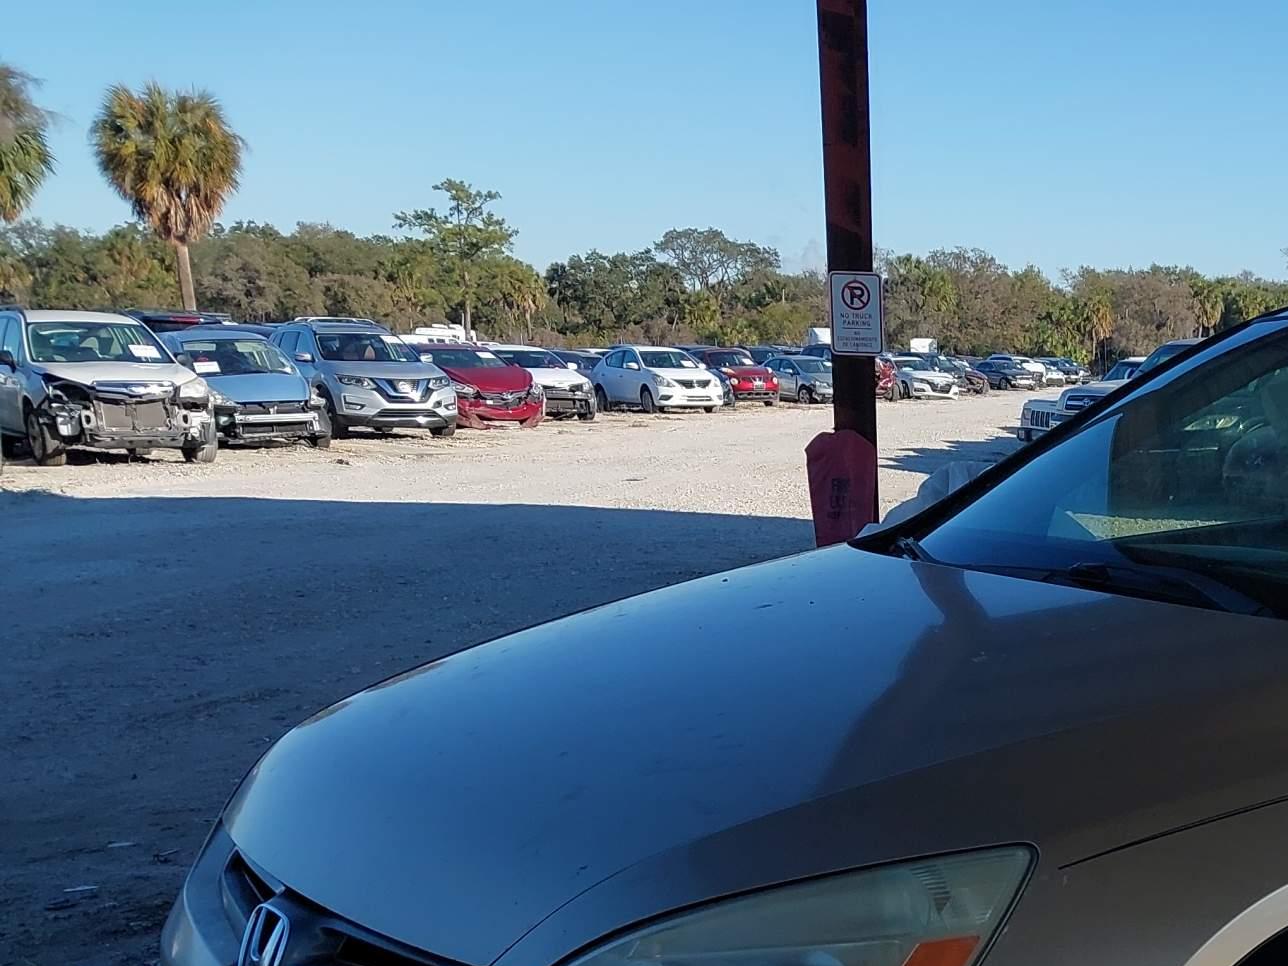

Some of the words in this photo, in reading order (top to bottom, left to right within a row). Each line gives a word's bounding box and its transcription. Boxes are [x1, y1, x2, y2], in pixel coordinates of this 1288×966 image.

[840, 312, 850, 320] NO
[852, 312, 873, 320] TRUCK
[842, 319, 871, 327] PARKING
